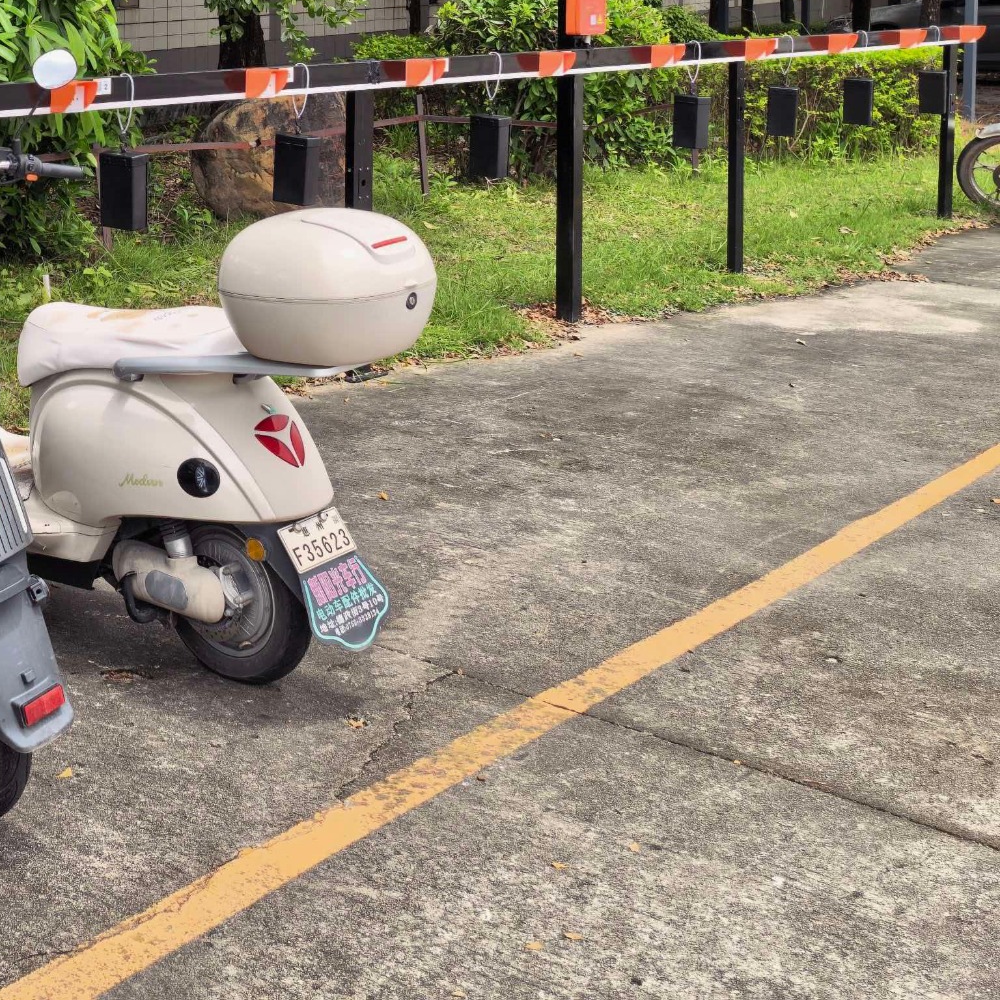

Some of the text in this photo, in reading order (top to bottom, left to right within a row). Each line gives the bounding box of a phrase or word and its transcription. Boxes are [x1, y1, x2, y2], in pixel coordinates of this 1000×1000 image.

[292, 529, 350, 566] F35623
[316, 582, 377, 621] 电动车配件批发
